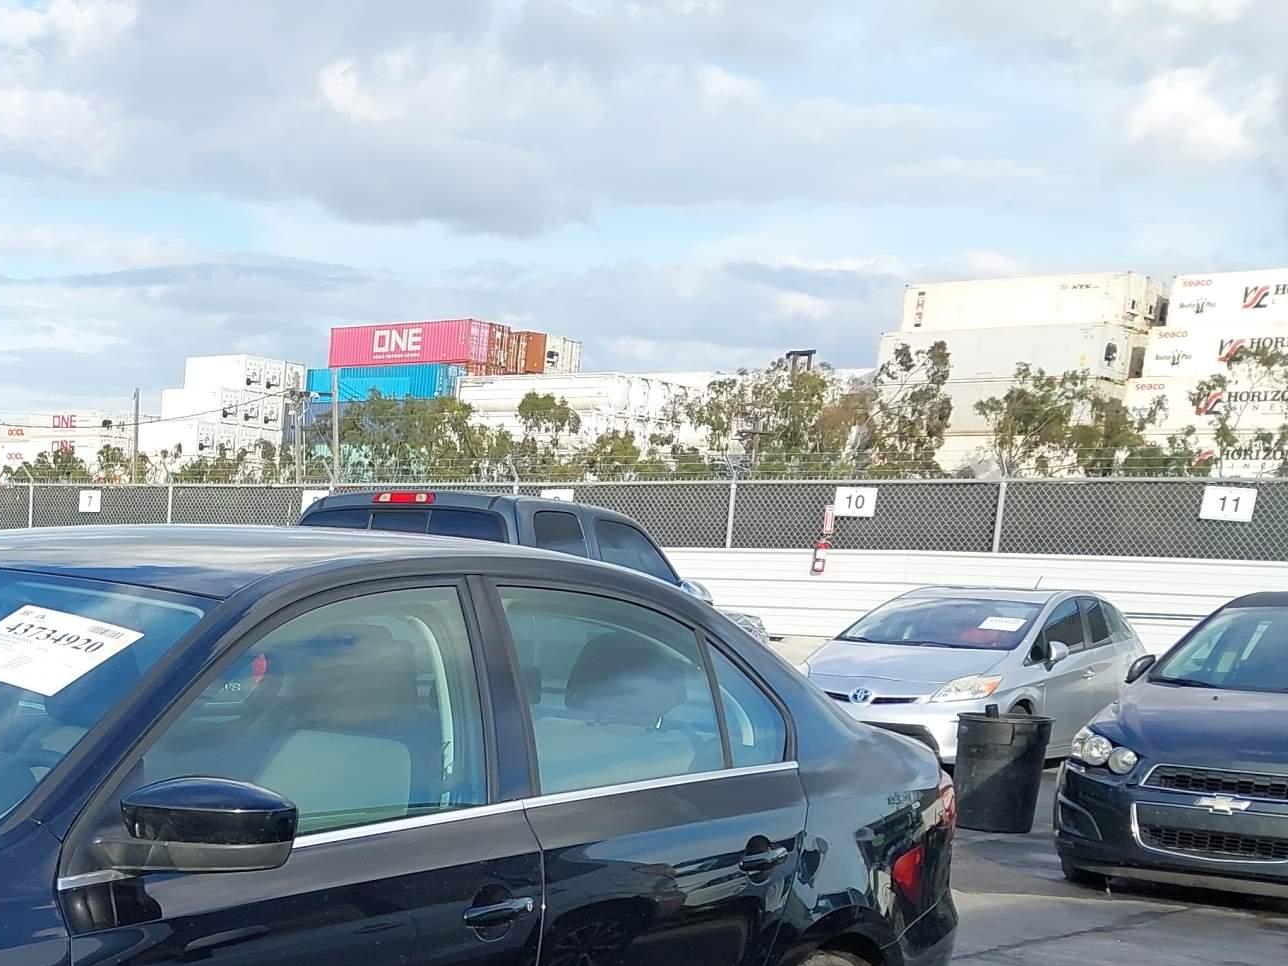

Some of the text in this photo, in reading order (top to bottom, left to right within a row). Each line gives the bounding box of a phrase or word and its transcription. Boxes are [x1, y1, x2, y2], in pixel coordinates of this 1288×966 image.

[1182, 279, 1213, 288] seaco
[373, 328, 422, 353] ONE
[1158, 330, 1188, 339] seaco
[1135, 382, 1165, 391] seaco
[52, 415, 77, 428] ONE
[7, 428, 25, 436] OOCL
[87, 495, 93, 506] 7
[846, 494, 865, 509] 10
[1219, 495, 1241, 513] 11
[7, 622, 104, 654] 43734920
